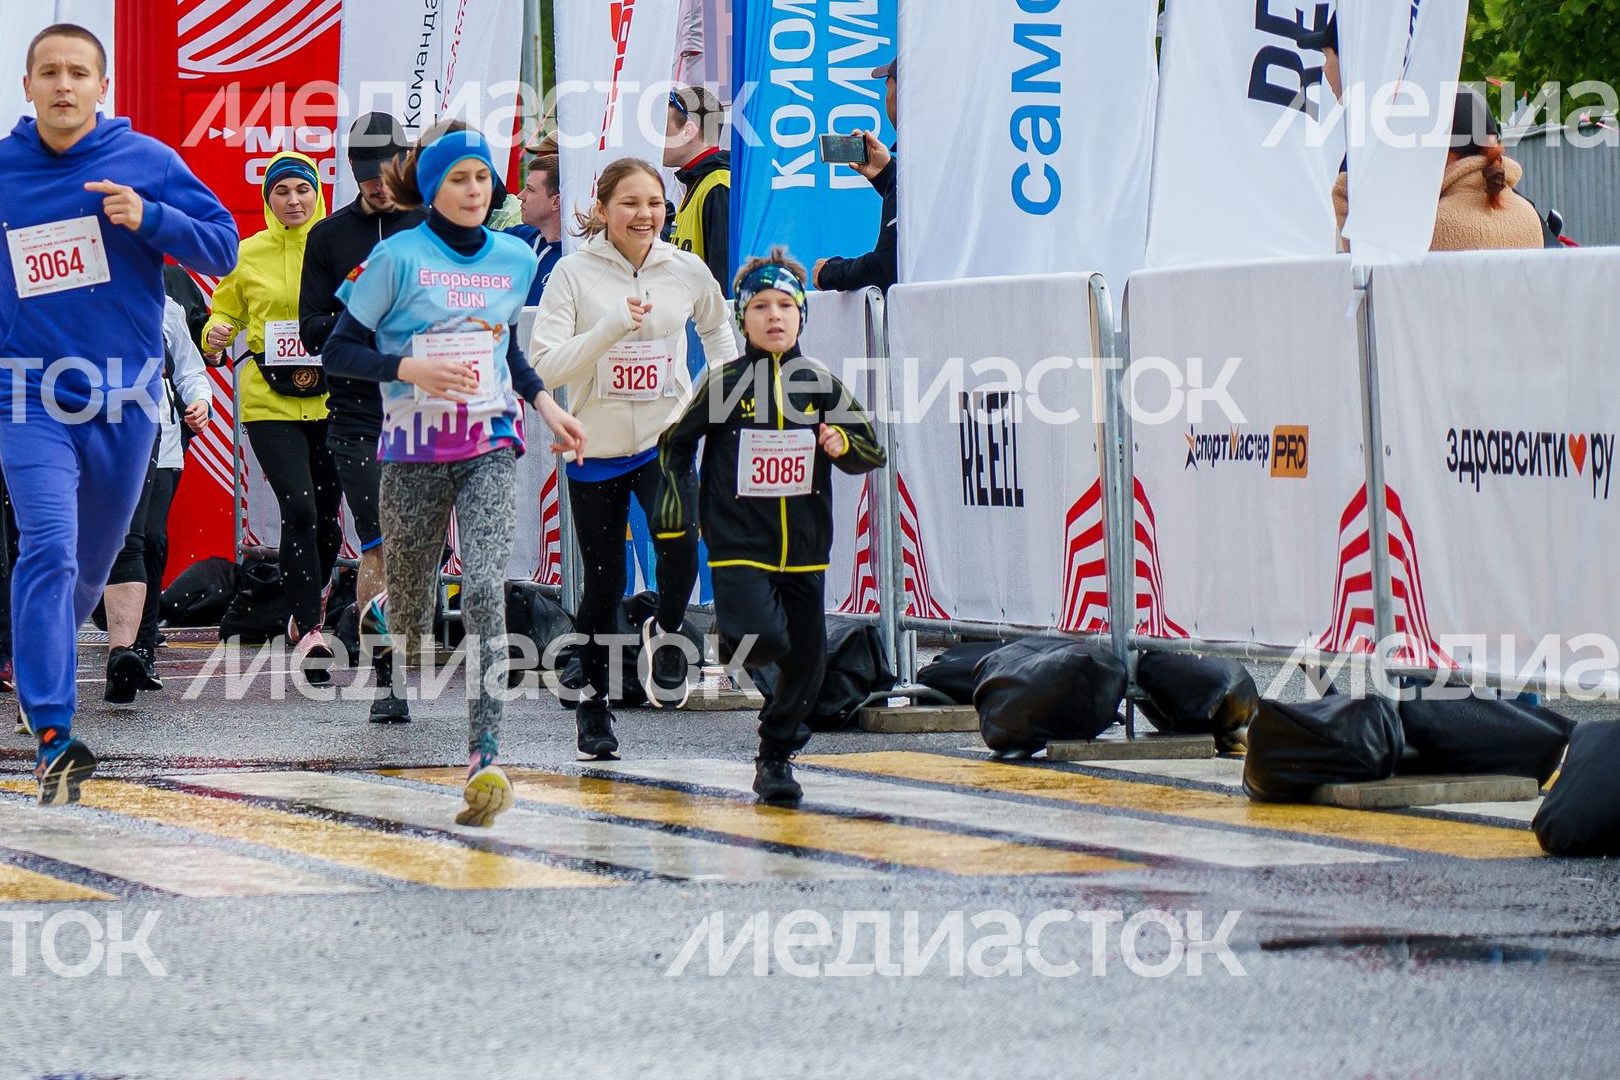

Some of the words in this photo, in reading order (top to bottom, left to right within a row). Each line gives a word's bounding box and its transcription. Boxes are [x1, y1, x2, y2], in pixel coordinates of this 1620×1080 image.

[25, 246, 84, 283] 3064
[419, 269, 512, 291] Егорьевск
[447, 291, 485, 308] RUN
[613, 364, 658, 390] 3126
[1274, 434, 1307, 470] PRO
[750, 456, 806, 485] 3085
